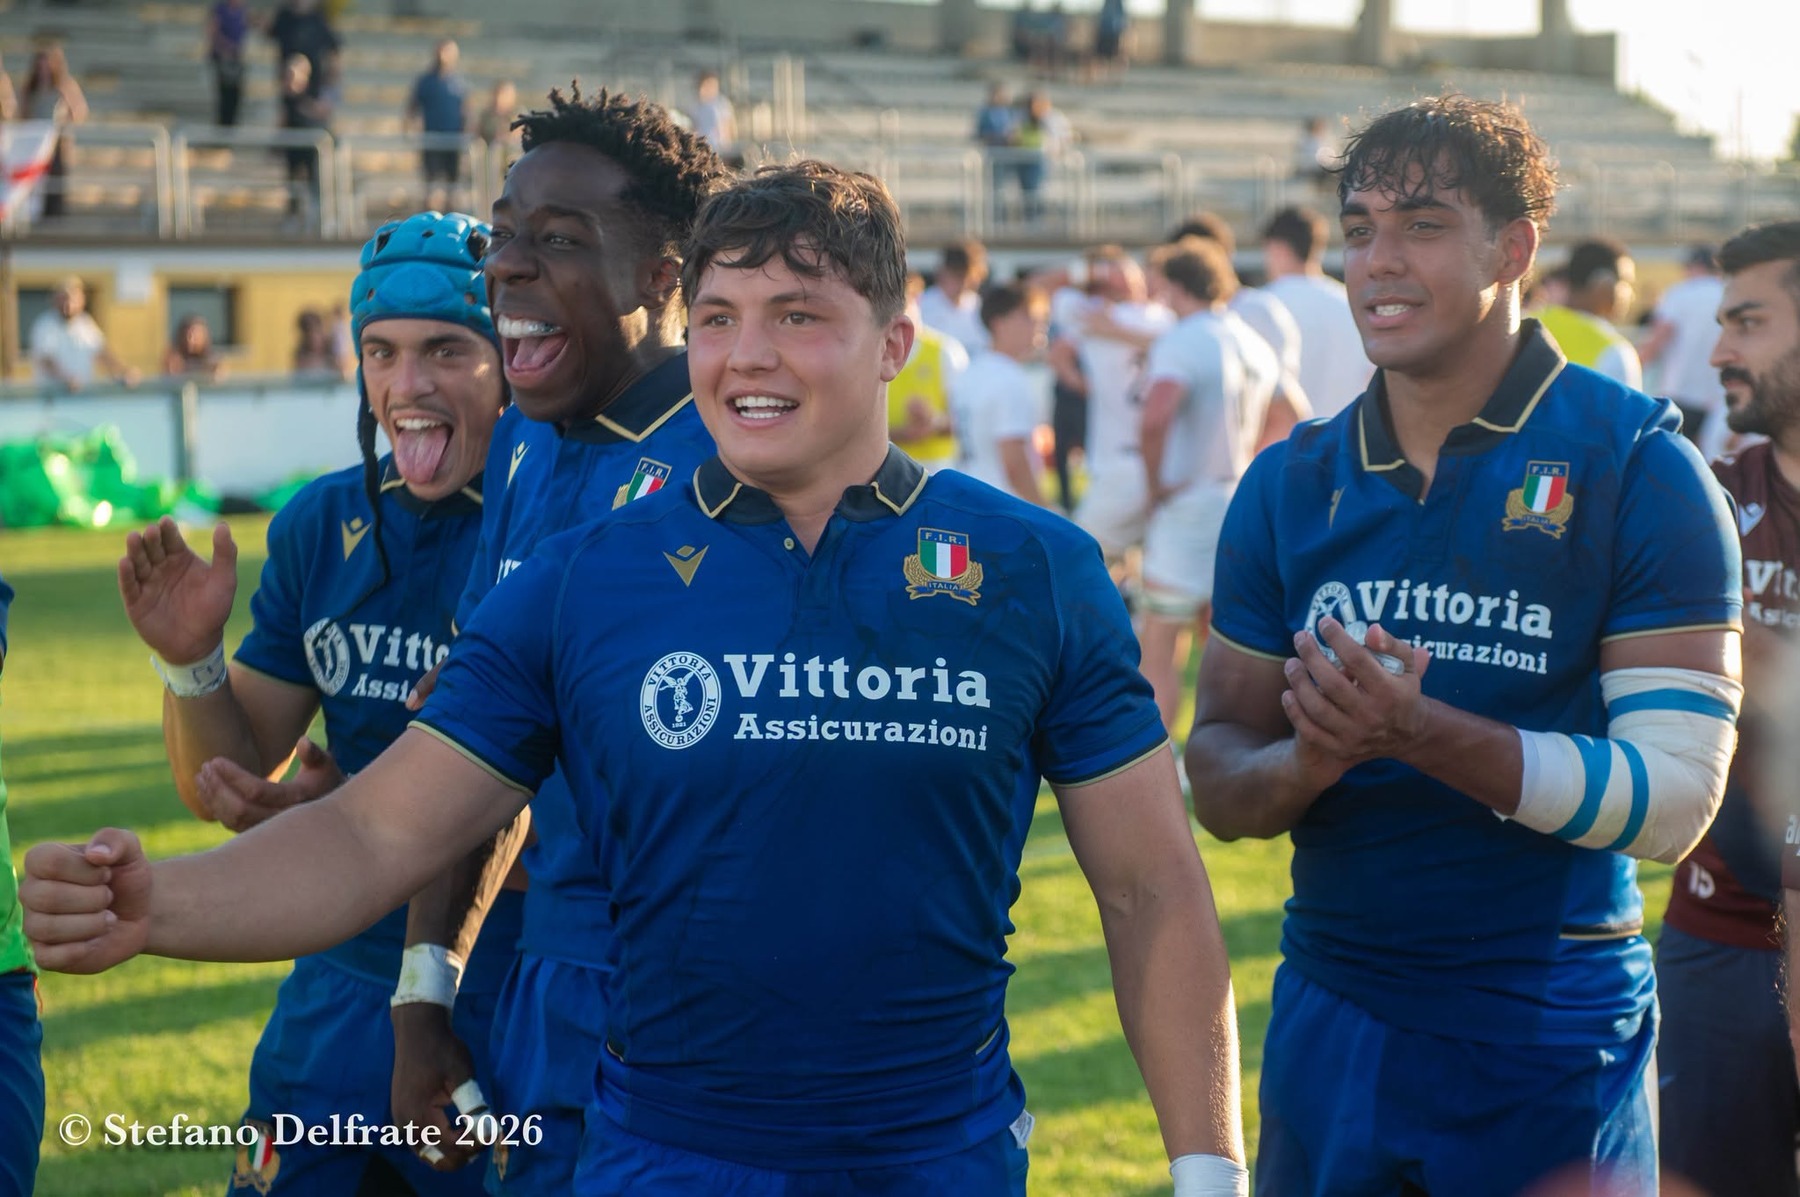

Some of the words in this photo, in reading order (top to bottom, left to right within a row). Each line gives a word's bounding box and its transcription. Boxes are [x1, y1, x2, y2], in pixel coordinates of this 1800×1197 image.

[925, 532, 962, 545] F.I.R.
[928, 582, 959, 591] ITALIA
[1356, 578, 1553, 639] Vittoria
[647, 655, 712, 687] VITTORIA
[1401, 634, 1548, 675] icurazioni
[723, 652, 991, 709] Vittoria
[644, 697, 717, 745] ASSICURAZIONI
[733, 713, 988, 751] Assicurazioni
